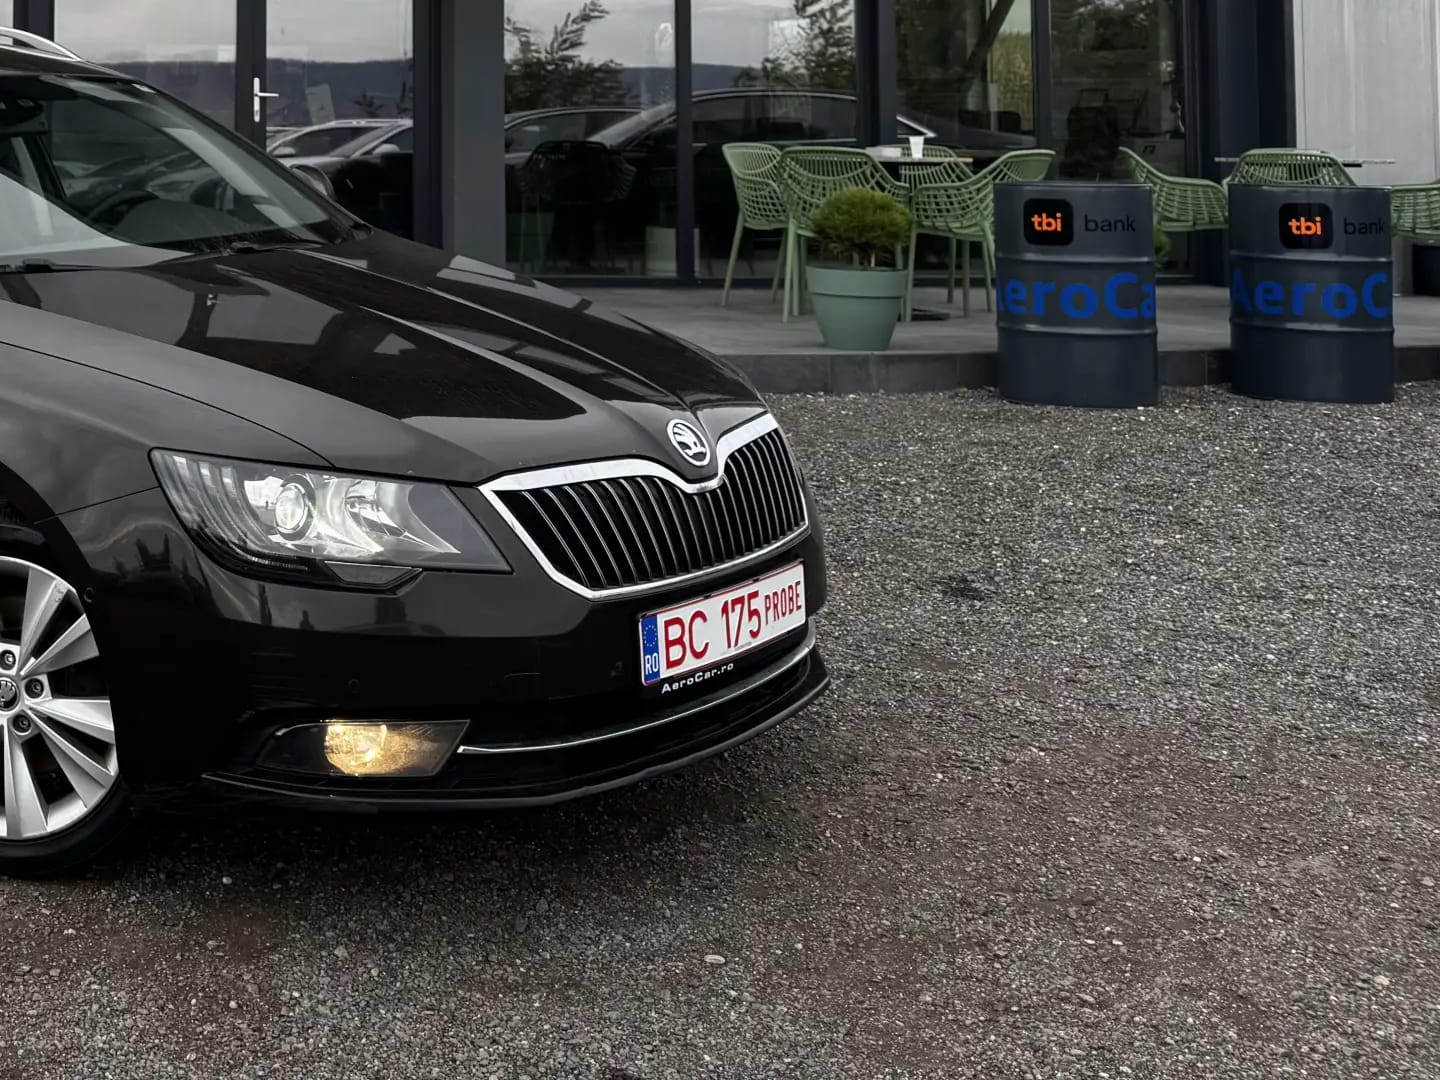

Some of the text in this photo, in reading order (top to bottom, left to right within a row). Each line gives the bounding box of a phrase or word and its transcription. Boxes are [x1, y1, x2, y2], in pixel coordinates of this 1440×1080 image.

[1031, 212, 1136, 233] tbi bank
[1288, 216, 1387, 236] tbi bank
[663, 580, 802, 670] BC 175 PROBE
[645, 652, 660, 676] RO
[661, 662, 734, 694] AeroCar.ro
